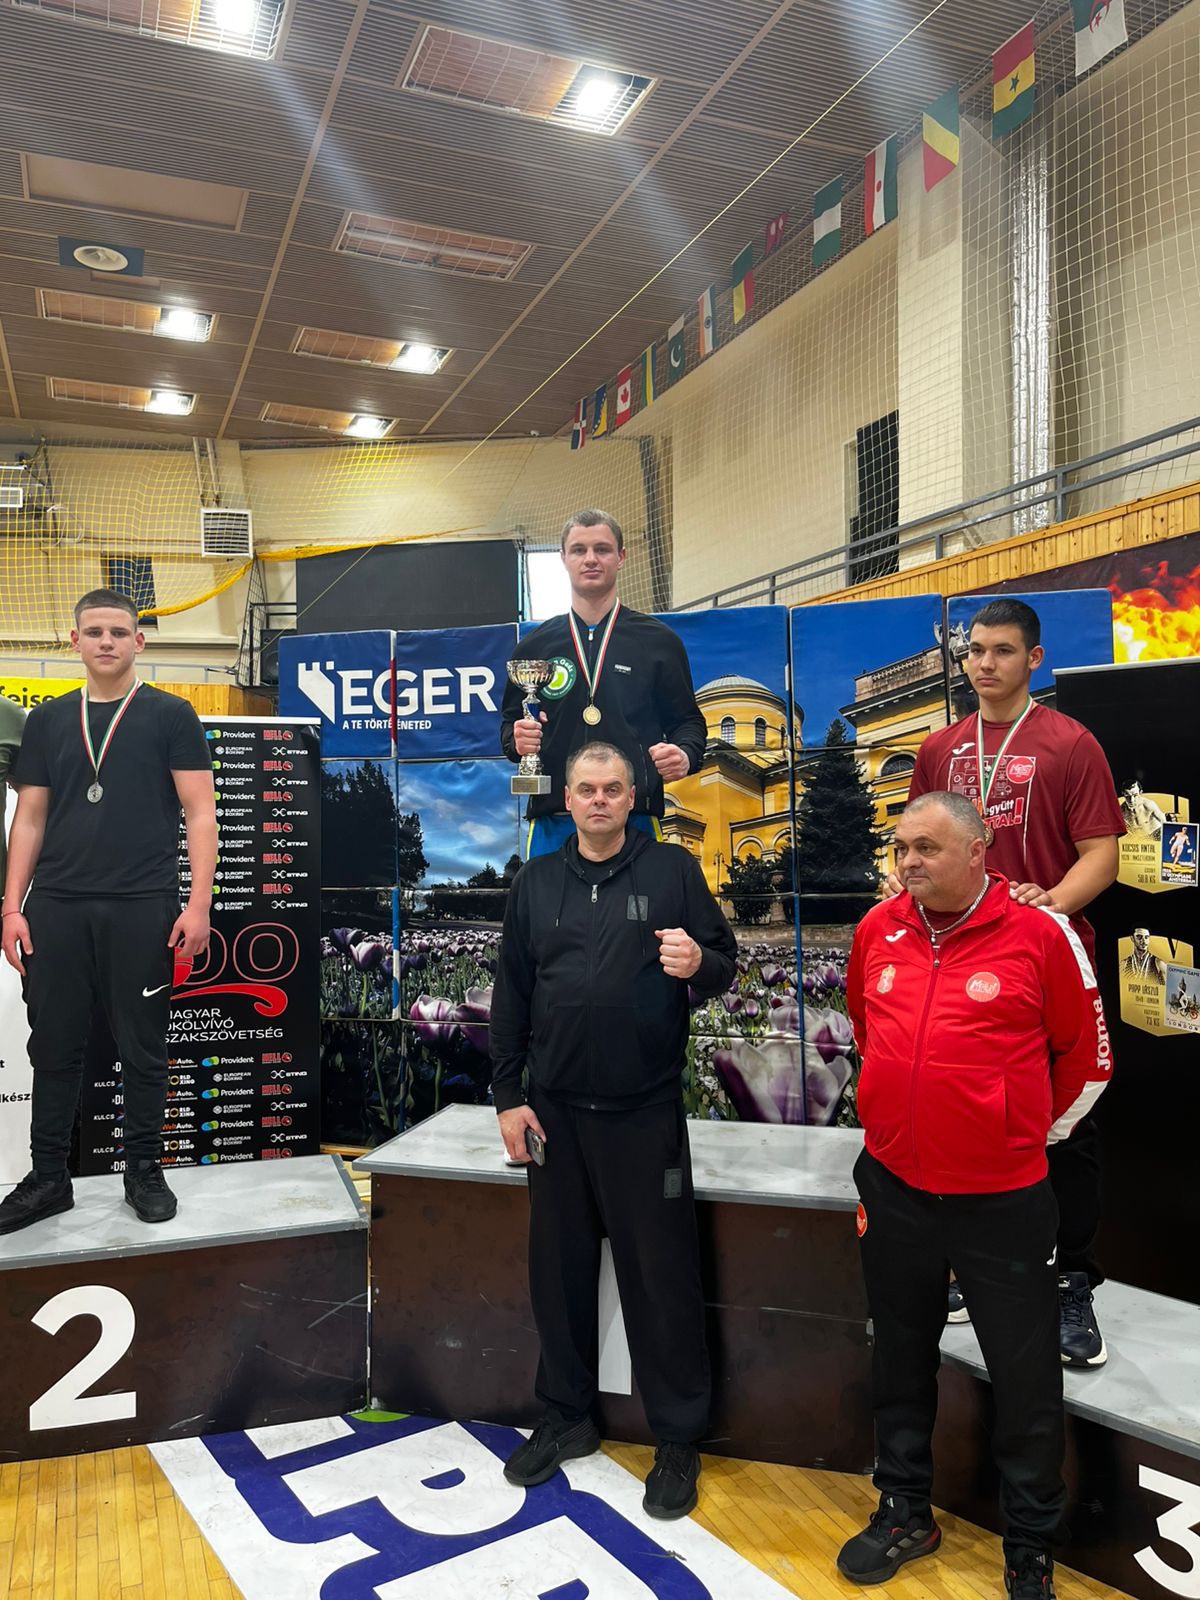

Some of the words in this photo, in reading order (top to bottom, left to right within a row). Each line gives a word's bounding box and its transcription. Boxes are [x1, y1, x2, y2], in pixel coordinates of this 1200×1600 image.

[337, 666, 498, 716] EGER
[342, 720, 350, 730] A
[351, 720, 362, 729] TE
[223, 731, 256, 739] Provident
[168, 1017, 234, 1031] KÖLVÍVÓ
[166, 1026, 284, 1043] SZAKSZÖVETSÉG
[1093, 995, 1111, 1071] Joma
[220, 1057, 255, 1065] Provident
[220, 1089, 255, 1097] Provident
[220, 1121, 254, 1129] Provident
[220, 1153, 254, 1161] Provident
[29, 1285, 137, 1431] 2
[1133, 1464, 1200, 1599] 3
